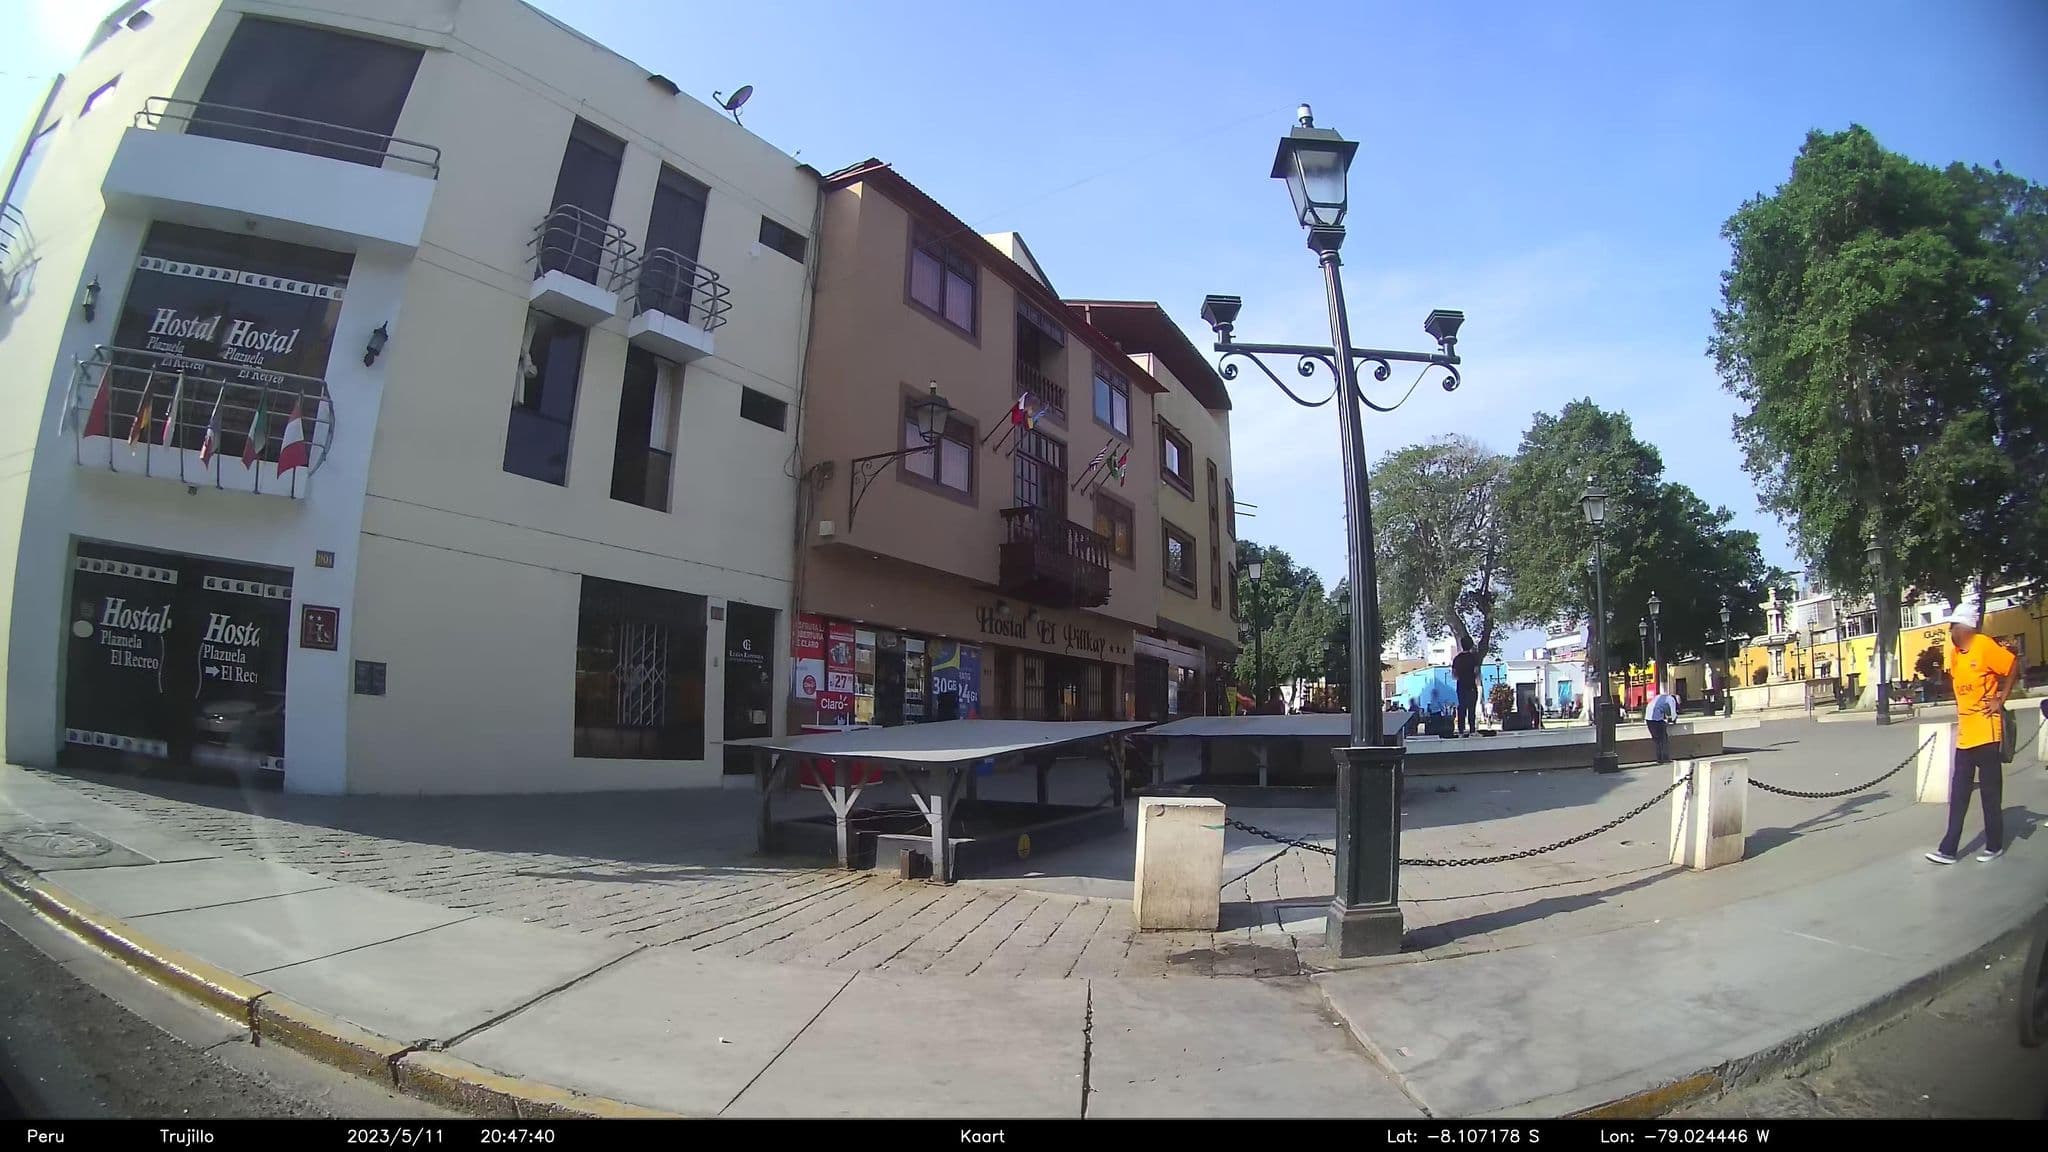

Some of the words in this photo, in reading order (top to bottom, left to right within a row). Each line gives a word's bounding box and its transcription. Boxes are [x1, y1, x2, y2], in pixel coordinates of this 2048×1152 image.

[148, 308, 222, 341] Hostal
[146, 336, 185, 353] Plazuela
[225, 319, 300, 354] Hostal
[223, 347, 265, 365] Plazuela
[100, 597, 171, 634] Hostal
[976, 607, 1027, 640] Hostal
[1036, 620, 1057, 645] El
[101, 630, 142, 649] Plazuela
[111, 649, 122, 666] El
[124, 652, 159, 670] Recreo
[203, 645, 246, 664] Plazuela
[221, 665, 233, 681] El
[834, 674, 847, 689] 27
[820, 697, 845, 710] Claro
